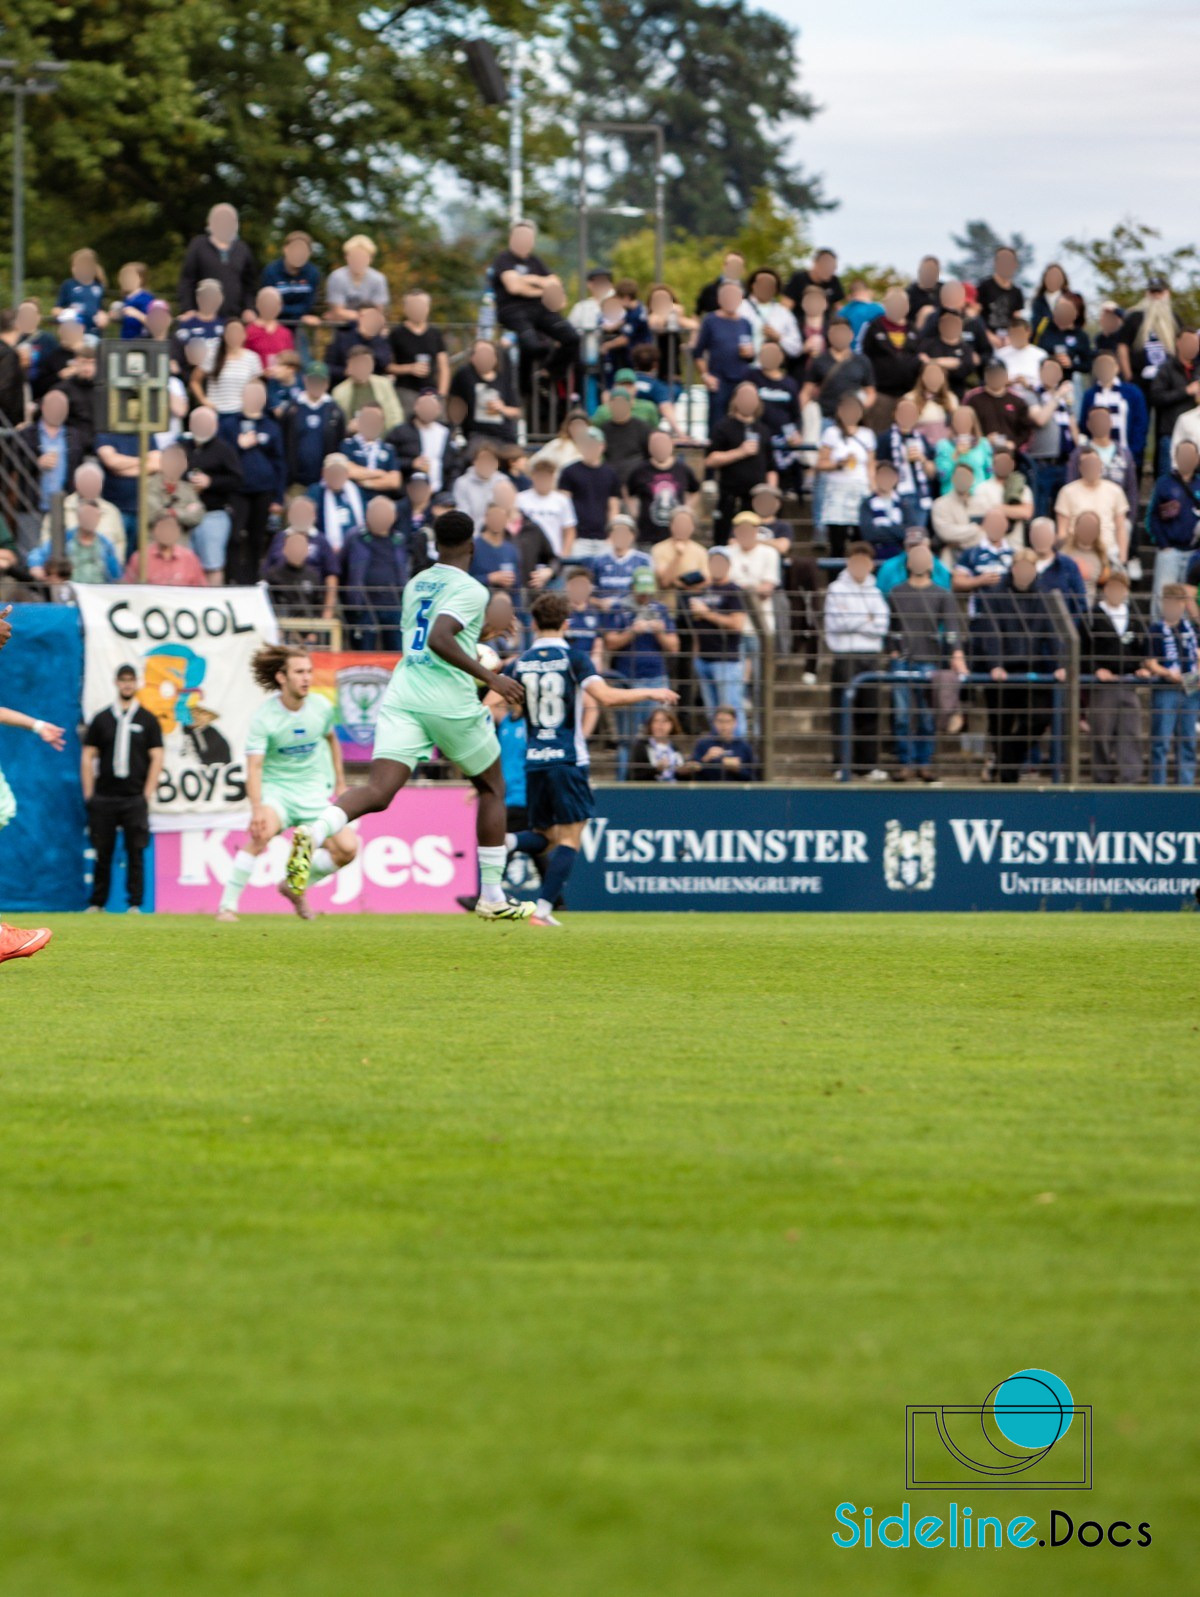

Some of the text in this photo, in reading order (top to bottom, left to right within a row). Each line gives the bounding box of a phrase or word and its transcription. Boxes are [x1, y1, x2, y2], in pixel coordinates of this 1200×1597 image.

[108, 599, 255, 640] COOOL
[411, 598, 434, 651] 5
[521, 671, 566, 729] 18
[156, 764, 247, 803] BOYS
[949, 818, 1200, 865] WESTMINST
[177, 828, 455, 905] Kajes
[605, 870, 823, 895] UNTERNEHMENSGRUPPE
